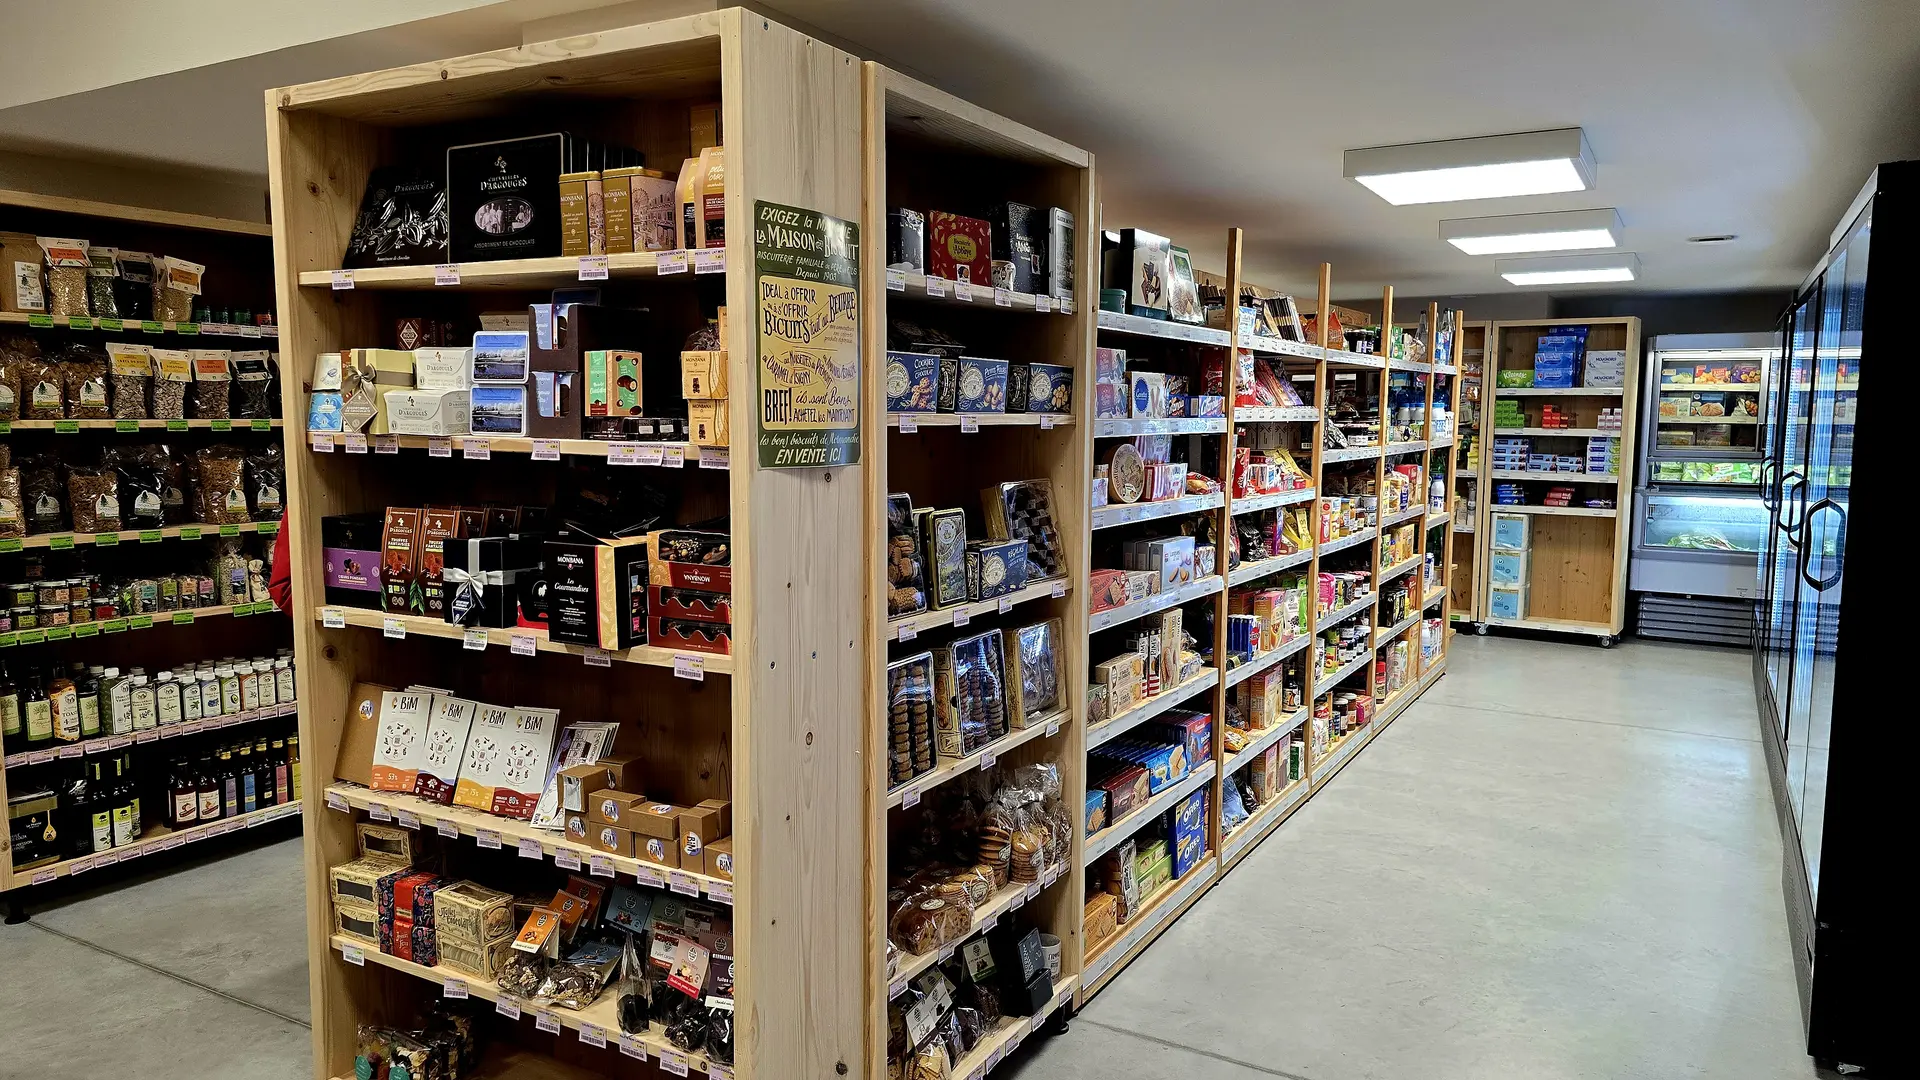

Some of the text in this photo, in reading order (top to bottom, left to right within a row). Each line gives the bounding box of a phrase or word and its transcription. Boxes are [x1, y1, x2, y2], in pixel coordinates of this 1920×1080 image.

[480, 176, 528, 191] D'ARGOUGES
[760, 206, 800, 226] EXIGEZ
[803, 215, 813, 228] la
[755, 229, 767, 244] LA
[767, 223, 815, 252] MAISON
[795, 256, 825, 268] FAMILIALE
[795, 266, 837, 281] Depuis 1903
[784, 286, 789, 300] à
[790, 287, 818, 306] OFFRIR
[828, 291, 856, 323] BEURRE
[767, 354, 789, 383] CARAMEL
[914, 358, 935, 369] COOKIES
[914, 369, 933, 380] CHOCOLAT
[1503, 372, 1527, 380] Kleenex
[398, 409, 428, 417] D'ARGOUGES
[764, 387, 792, 425] BREF!
[796, 390, 808, 404] ils
[809, 390, 828, 405] sont
[793, 408, 817, 423] ACHETEZ
[770, 433, 789, 448] bons
[790, 432, 818, 448] biscuits
[819, 433, 828, 445] de
[774, 448, 842, 464] EN VENTE ICI
[557, 555, 584, 564] MONBANA
[683, 574, 711, 583] MONBANA
[554, 582, 589, 593] Gourmandises
[400, 696, 419, 711] BiM
[447, 703, 464, 719] BiM
[488, 710, 507, 726] BiM
[524, 715, 544, 731] BiM
[1183, 799, 1200, 822] OREO
[1184, 835, 1201, 859] OREO
